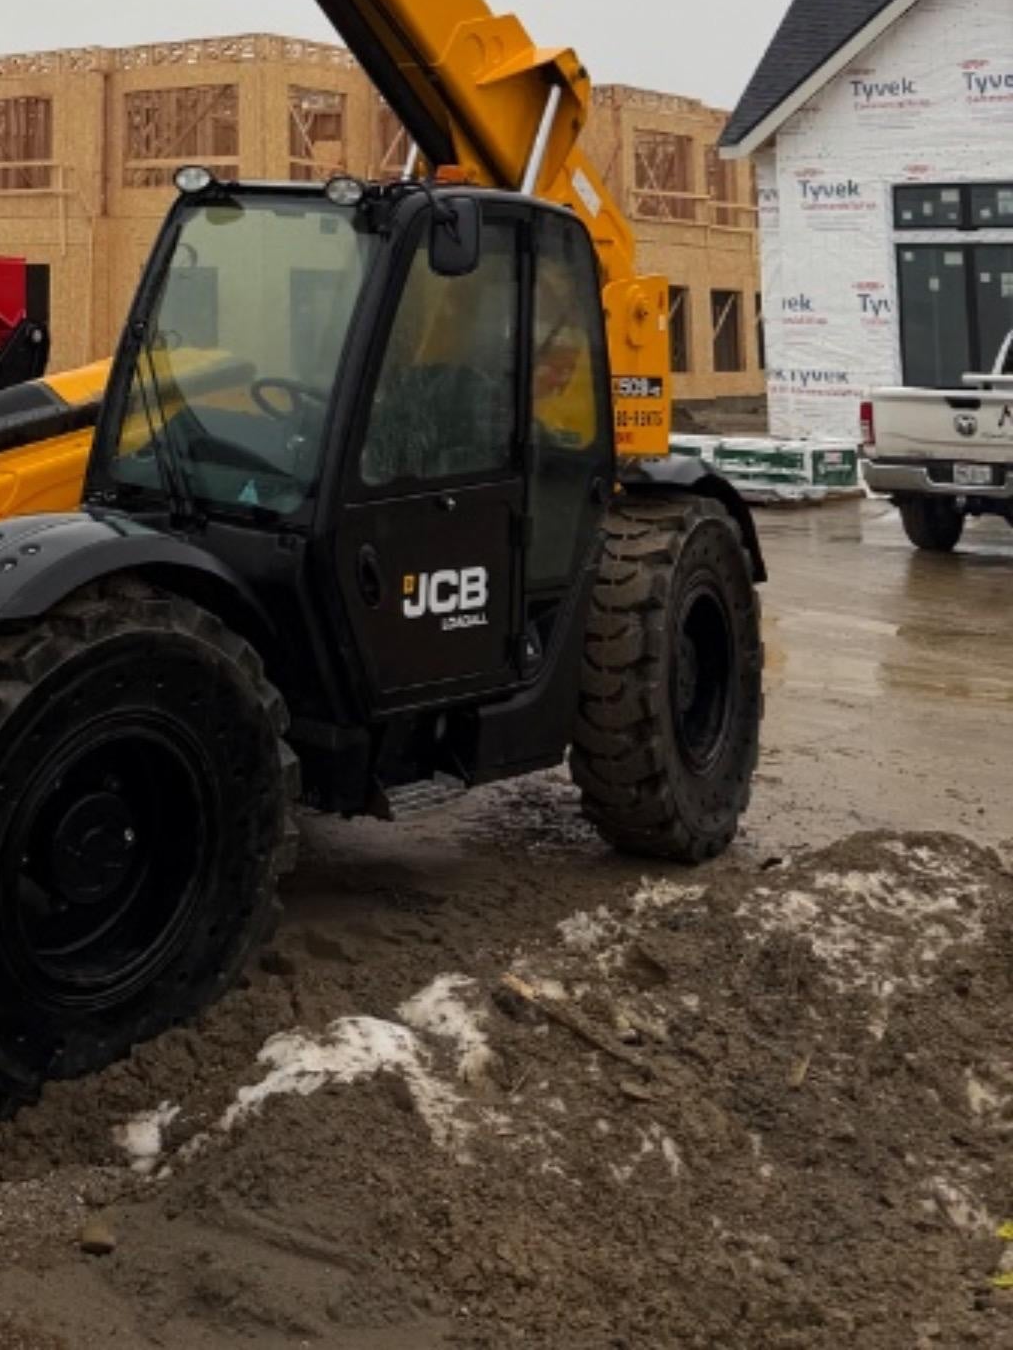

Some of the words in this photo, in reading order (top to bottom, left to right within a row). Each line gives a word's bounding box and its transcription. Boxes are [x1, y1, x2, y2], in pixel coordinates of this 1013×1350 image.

[850, 77, 917, 101] Tyvek
[797, 179, 860, 201] Tyvek
[403, 566, 487, 618] JCB
